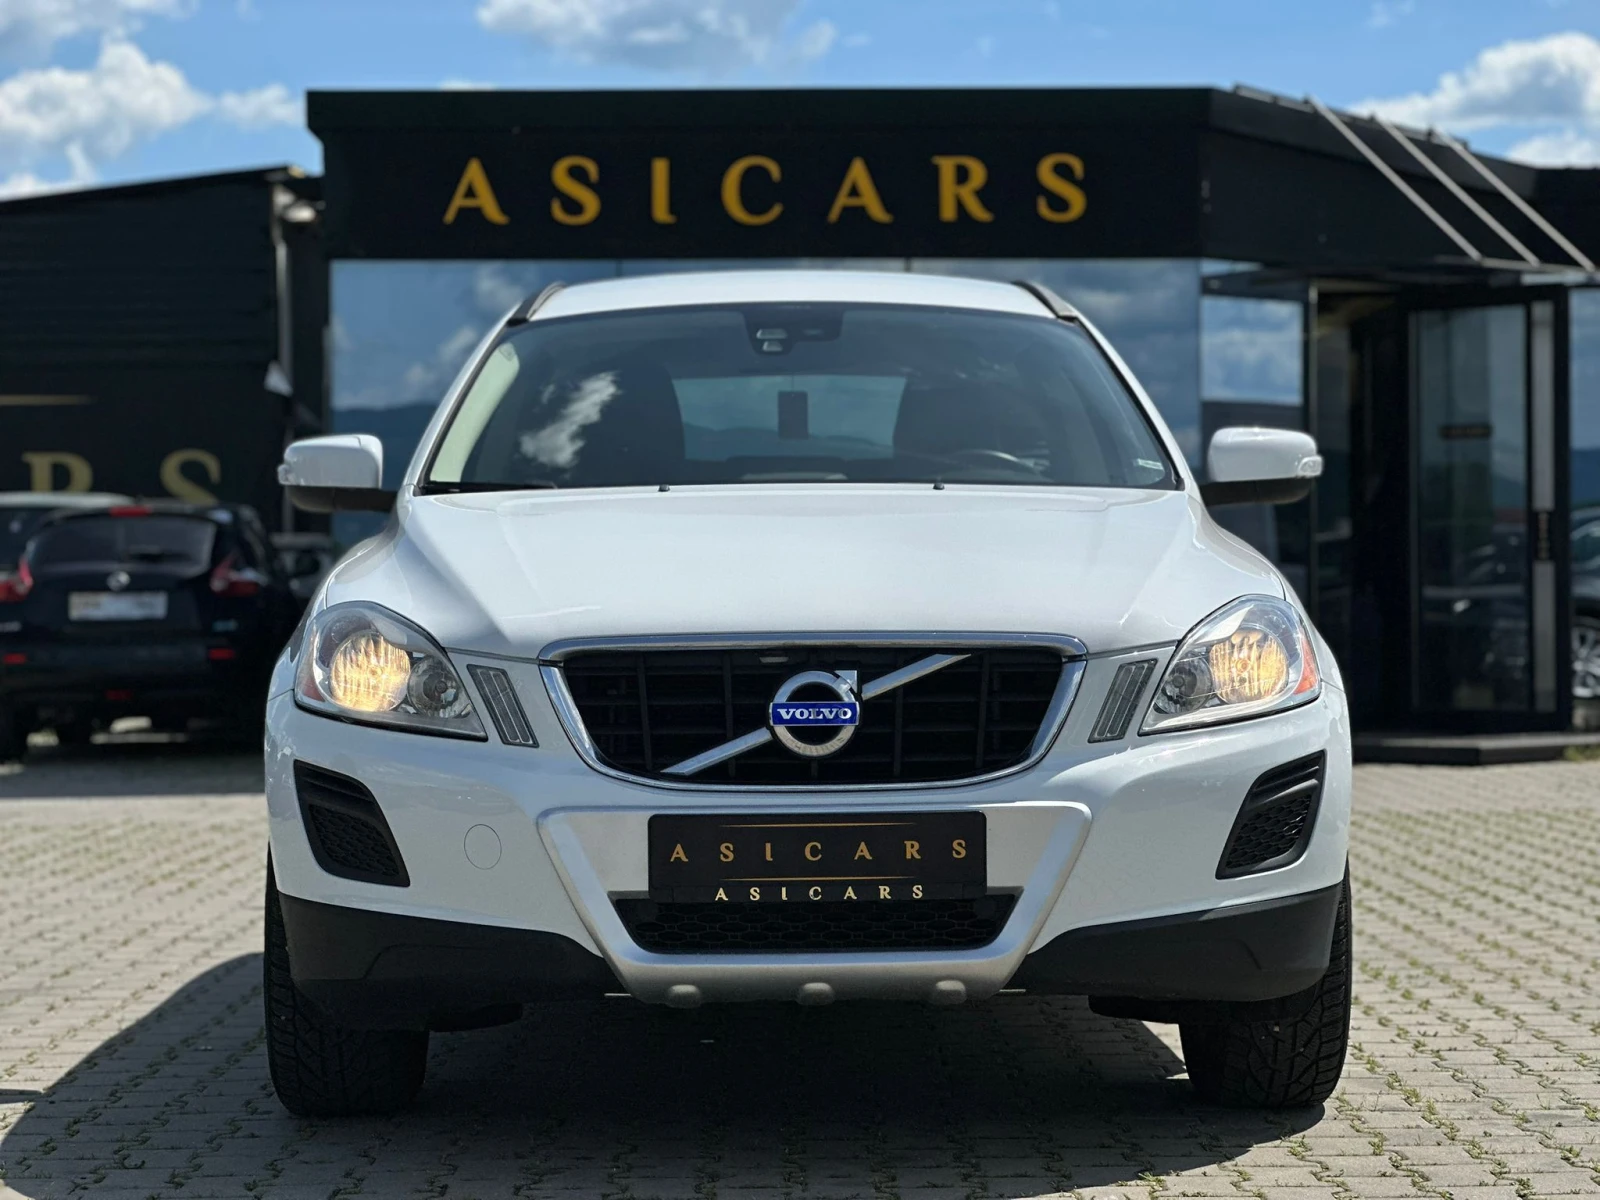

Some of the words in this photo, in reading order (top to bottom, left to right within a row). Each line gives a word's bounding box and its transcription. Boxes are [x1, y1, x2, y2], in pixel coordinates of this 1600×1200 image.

[443, 153, 1088, 225] ASICARS
[776, 707, 852, 720] VOLVO
[669, 839, 967, 863] ASICARS
[714, 885, 924, 901] ASICARS
